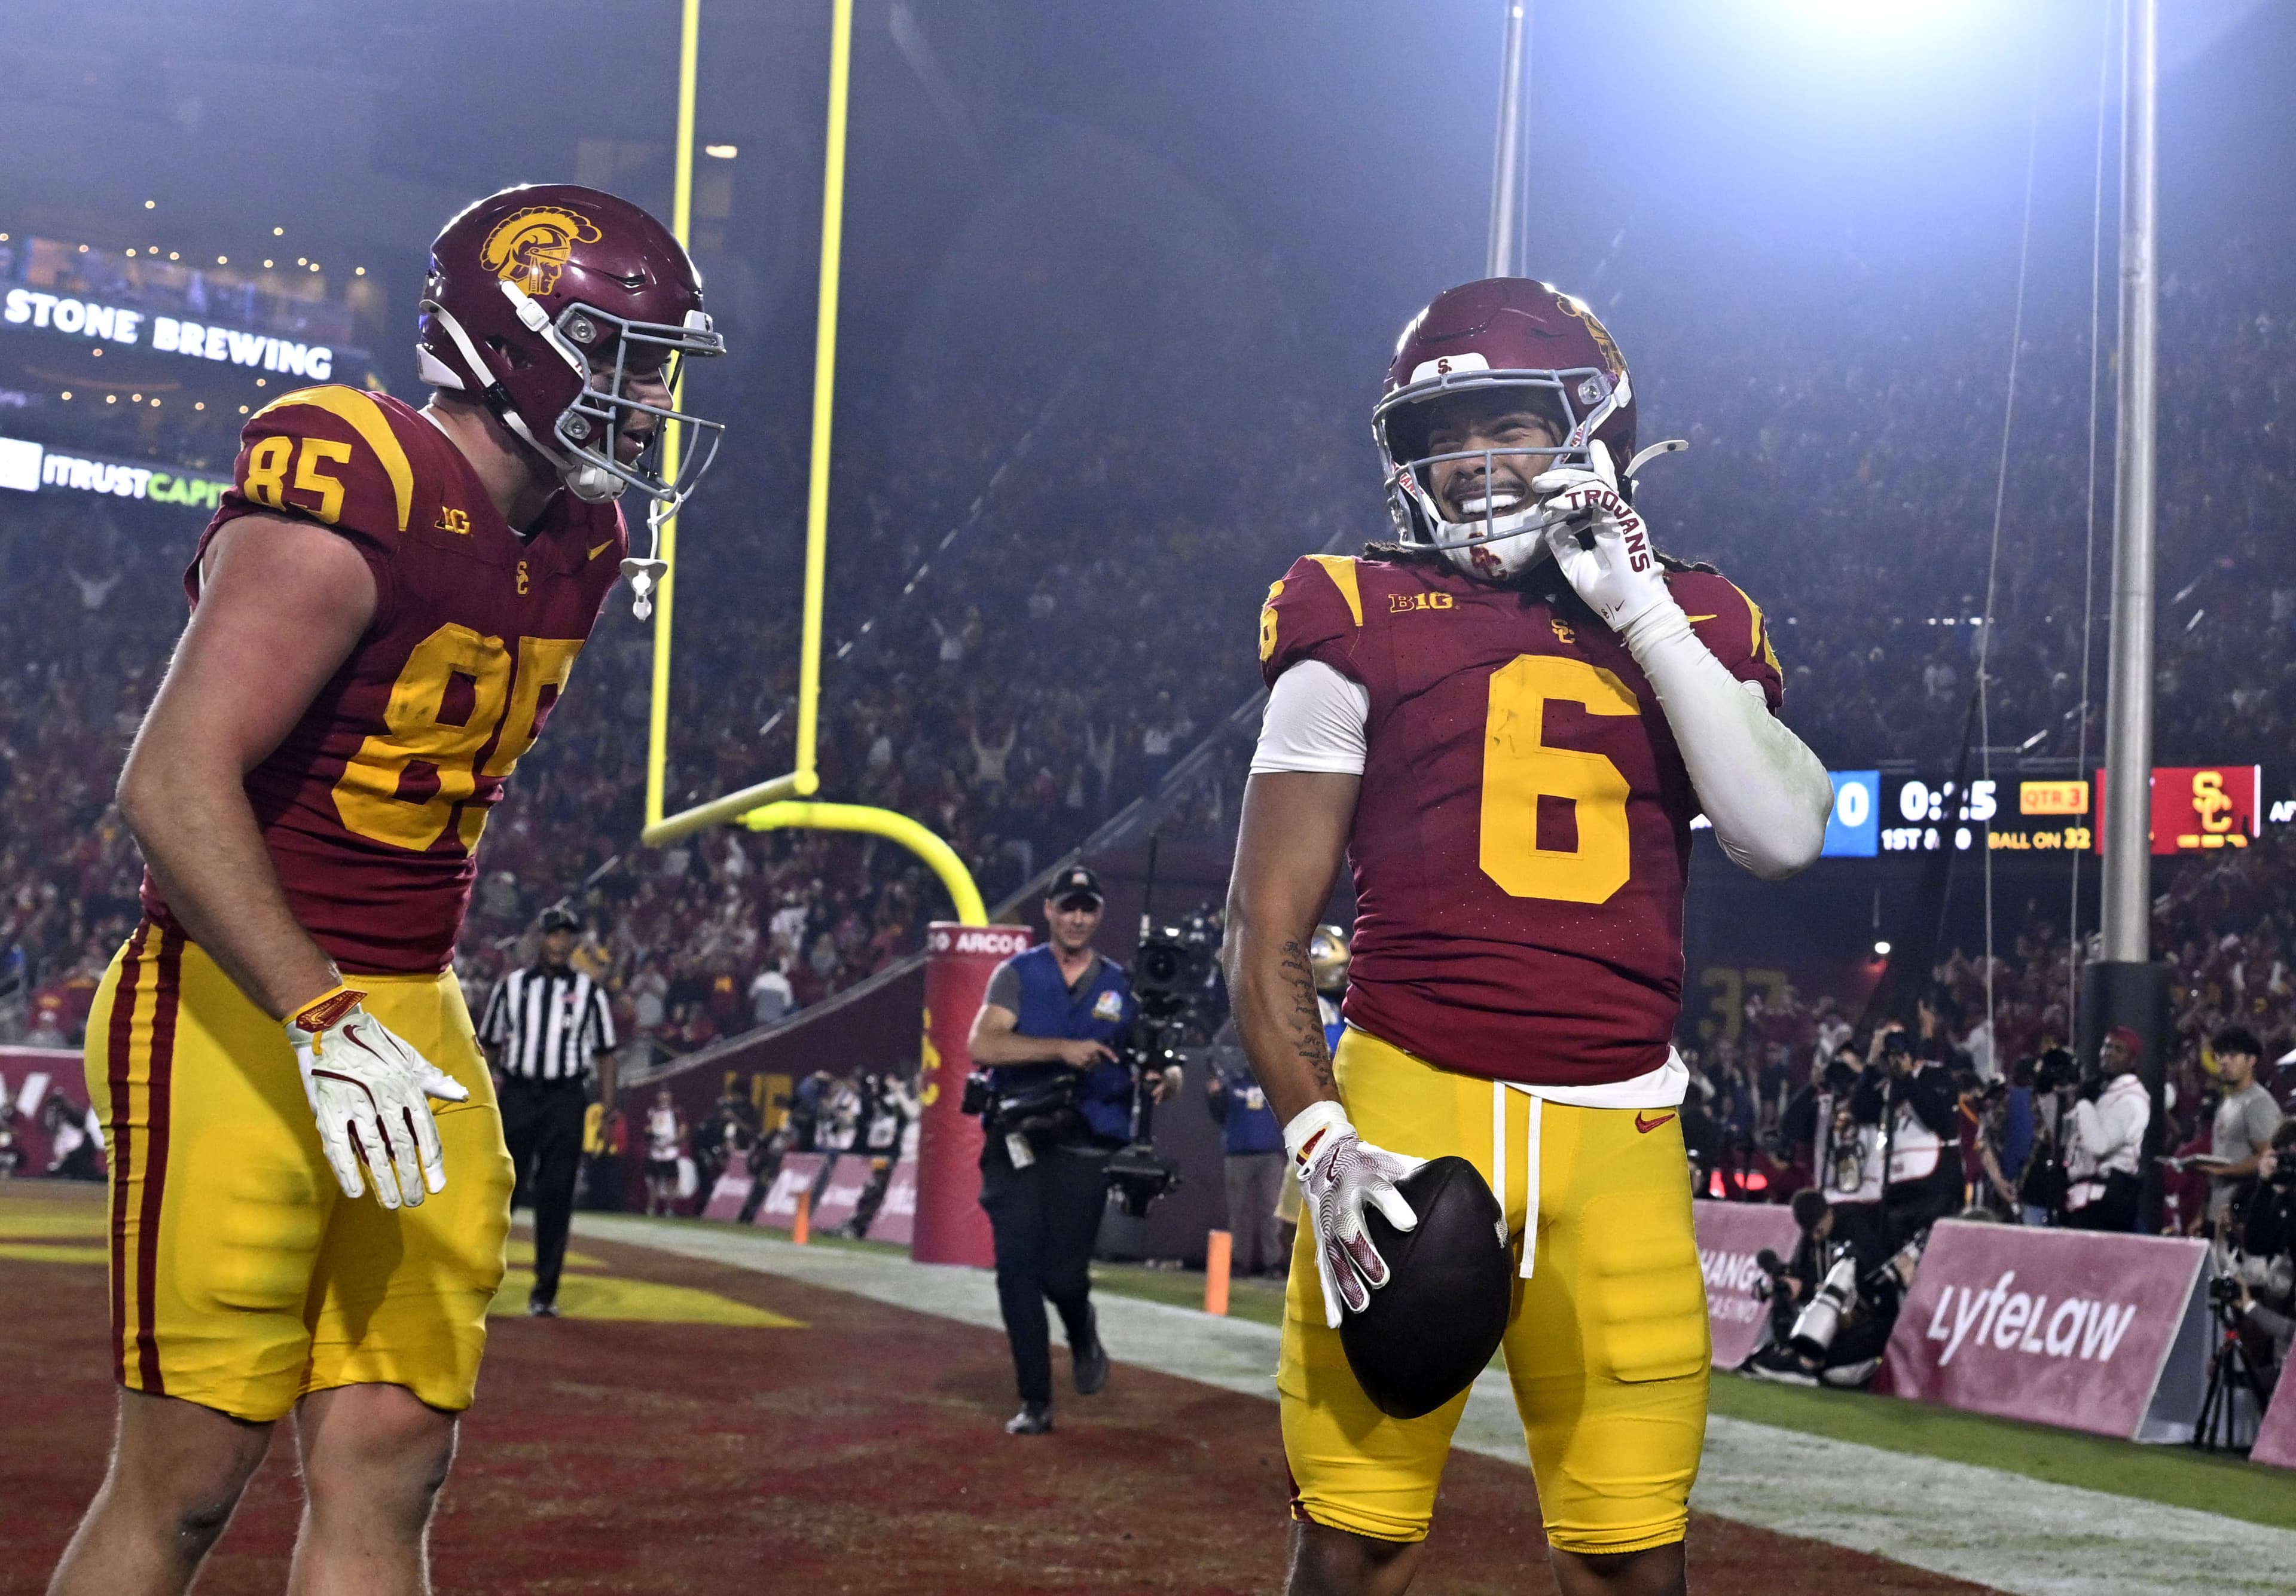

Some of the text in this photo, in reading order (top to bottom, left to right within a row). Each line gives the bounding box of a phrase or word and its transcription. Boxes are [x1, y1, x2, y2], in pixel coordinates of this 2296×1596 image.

[4, 289, 333, 380] STONE BREWING
[243, 436, 352, 524] 85
[1565, 490, 1650, 573] TROJANS
[331, 622, 586, 858] 85
[1479, 653, 1641, 904] 6
[1882, 828, 1922, 850] 1ST
[1988, 827, 2091, 849] BALL ON 32
[2025, 788, 2081, 805] QTR 3
